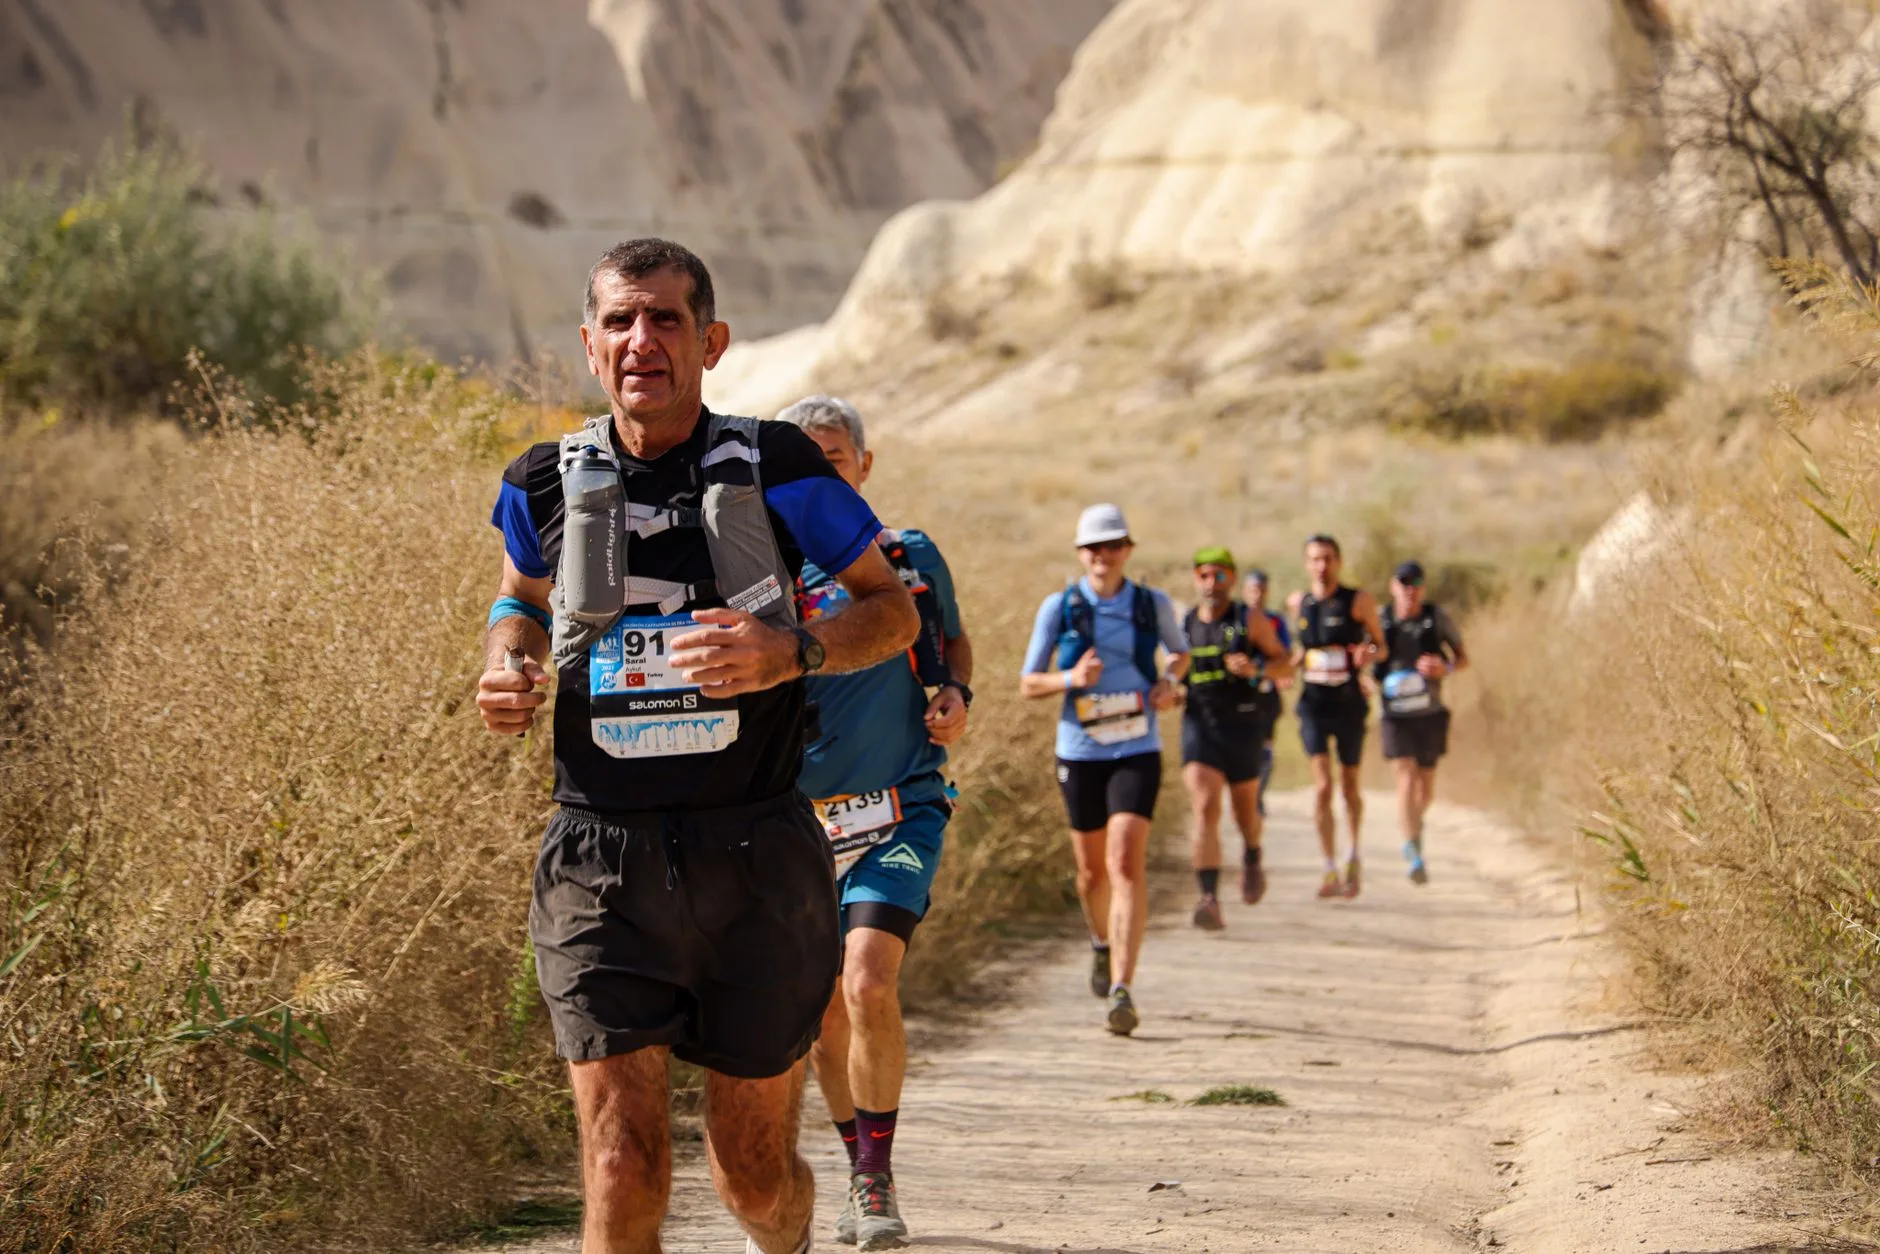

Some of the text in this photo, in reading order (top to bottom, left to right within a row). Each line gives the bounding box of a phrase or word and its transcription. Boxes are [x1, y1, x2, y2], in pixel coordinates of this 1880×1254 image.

[624, 630, 665, 657] 91
[625, 657, 646, 665] Saral
[825, 790, 884, 818] 2139
